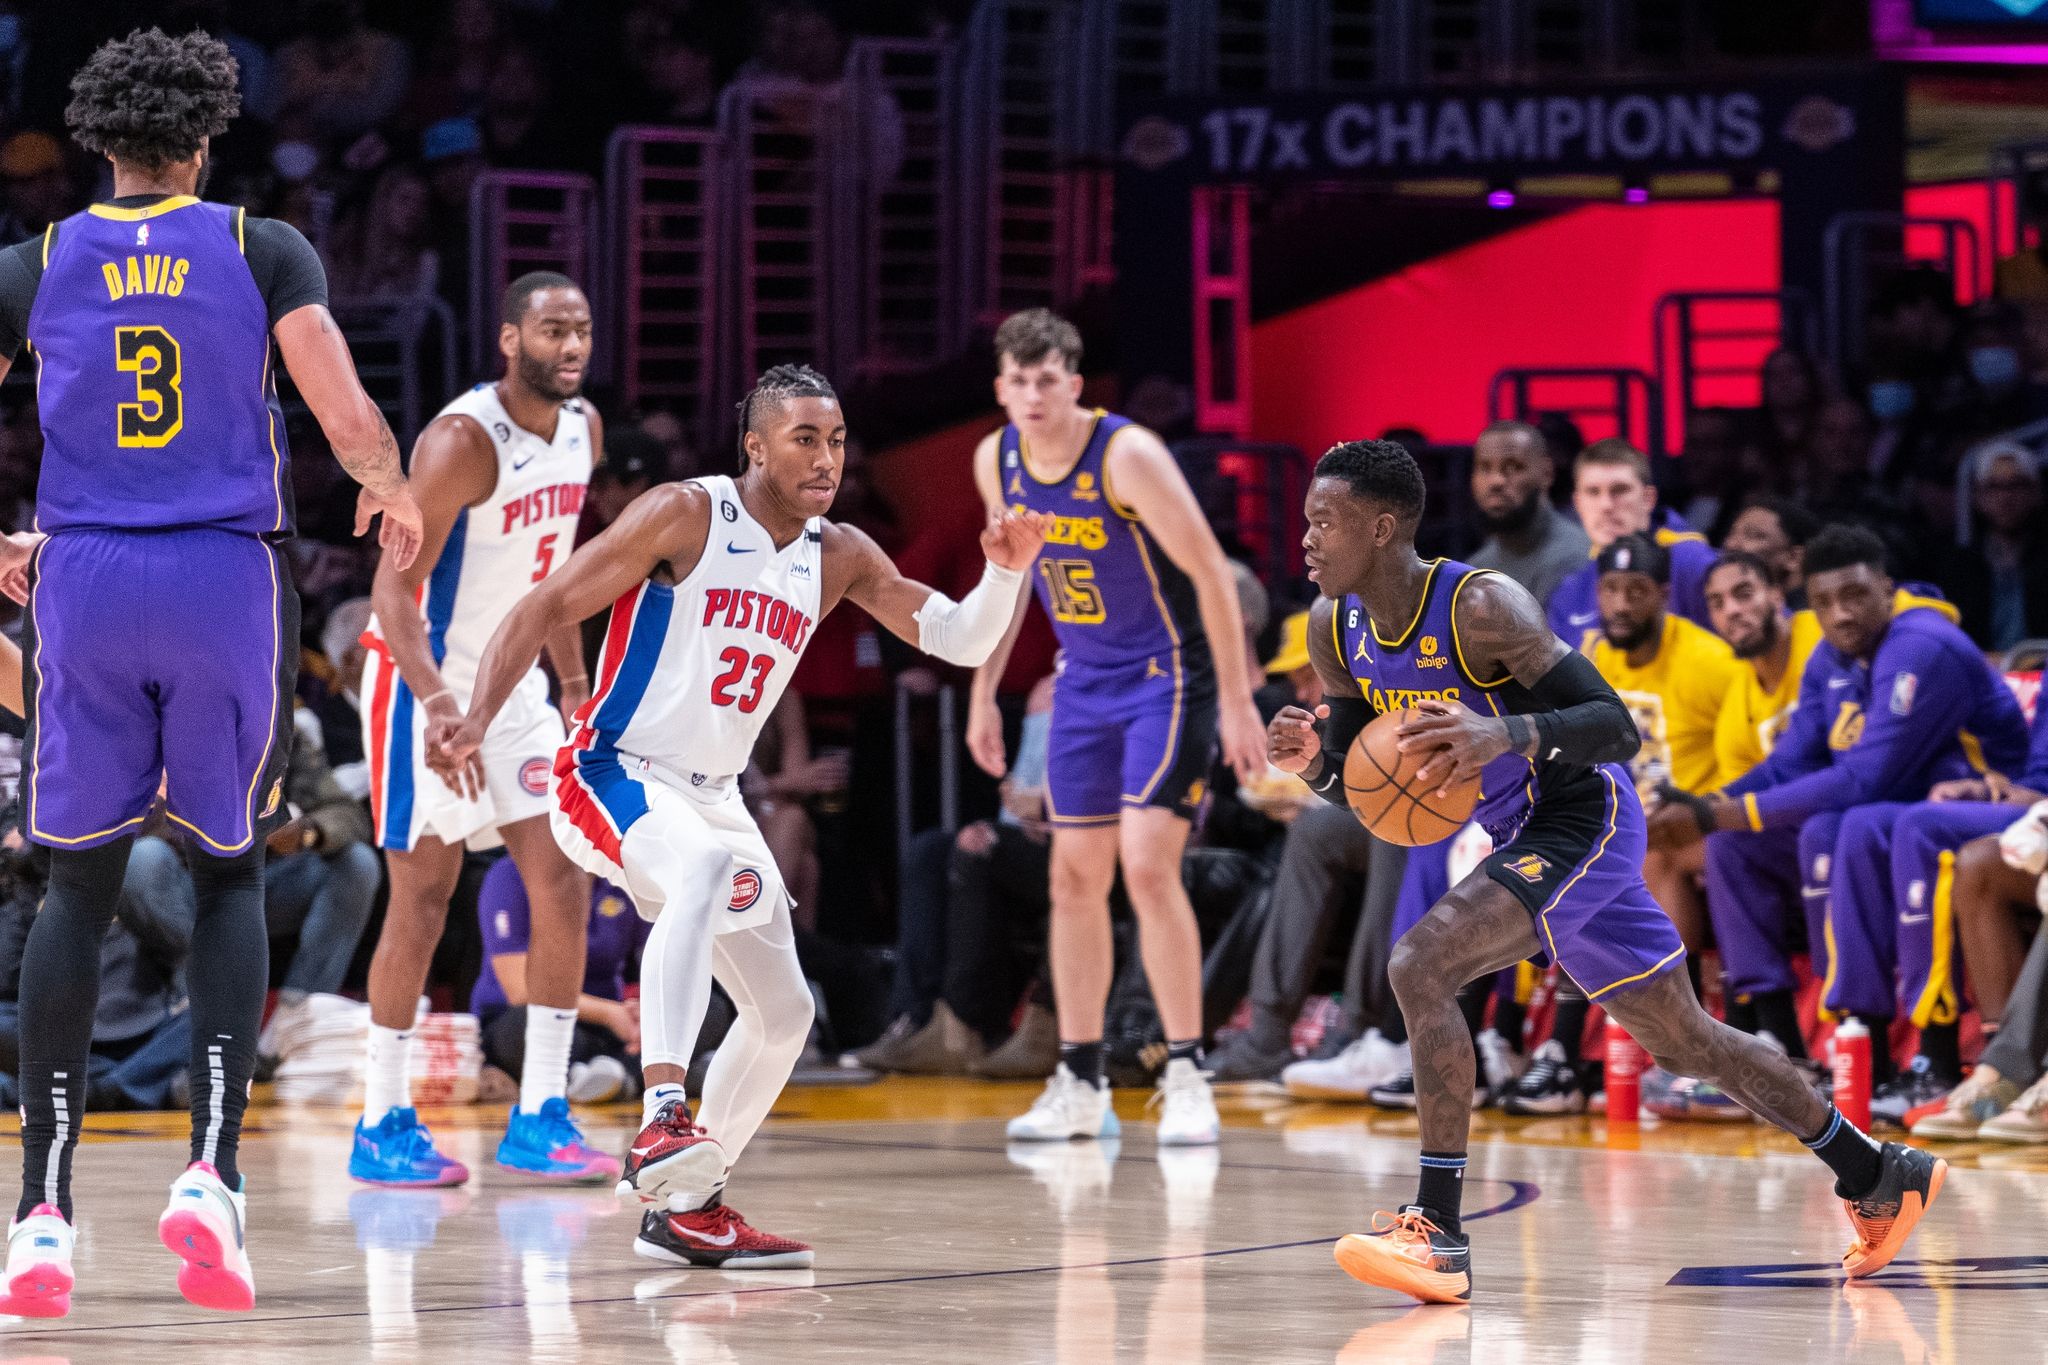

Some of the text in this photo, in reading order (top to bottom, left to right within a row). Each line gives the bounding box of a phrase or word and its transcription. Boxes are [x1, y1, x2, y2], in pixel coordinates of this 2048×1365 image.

[1202, 93, 1763, 171] 17x CHAMPIONS
[102, 254, 190, 301] DAVIS
[115, 325, 183, 448] 3
[531, 533, 559, 584] 5
[1038, 557, 1107, 625] 15
[1348, 609, 1359, 629] 6
[702, 588, 812, 655] PISTONS
[711, 645, 776, 714] 23
[1415, 656, 1448, 669] bibigo
[733, 881, 755, 892] ETROIT
